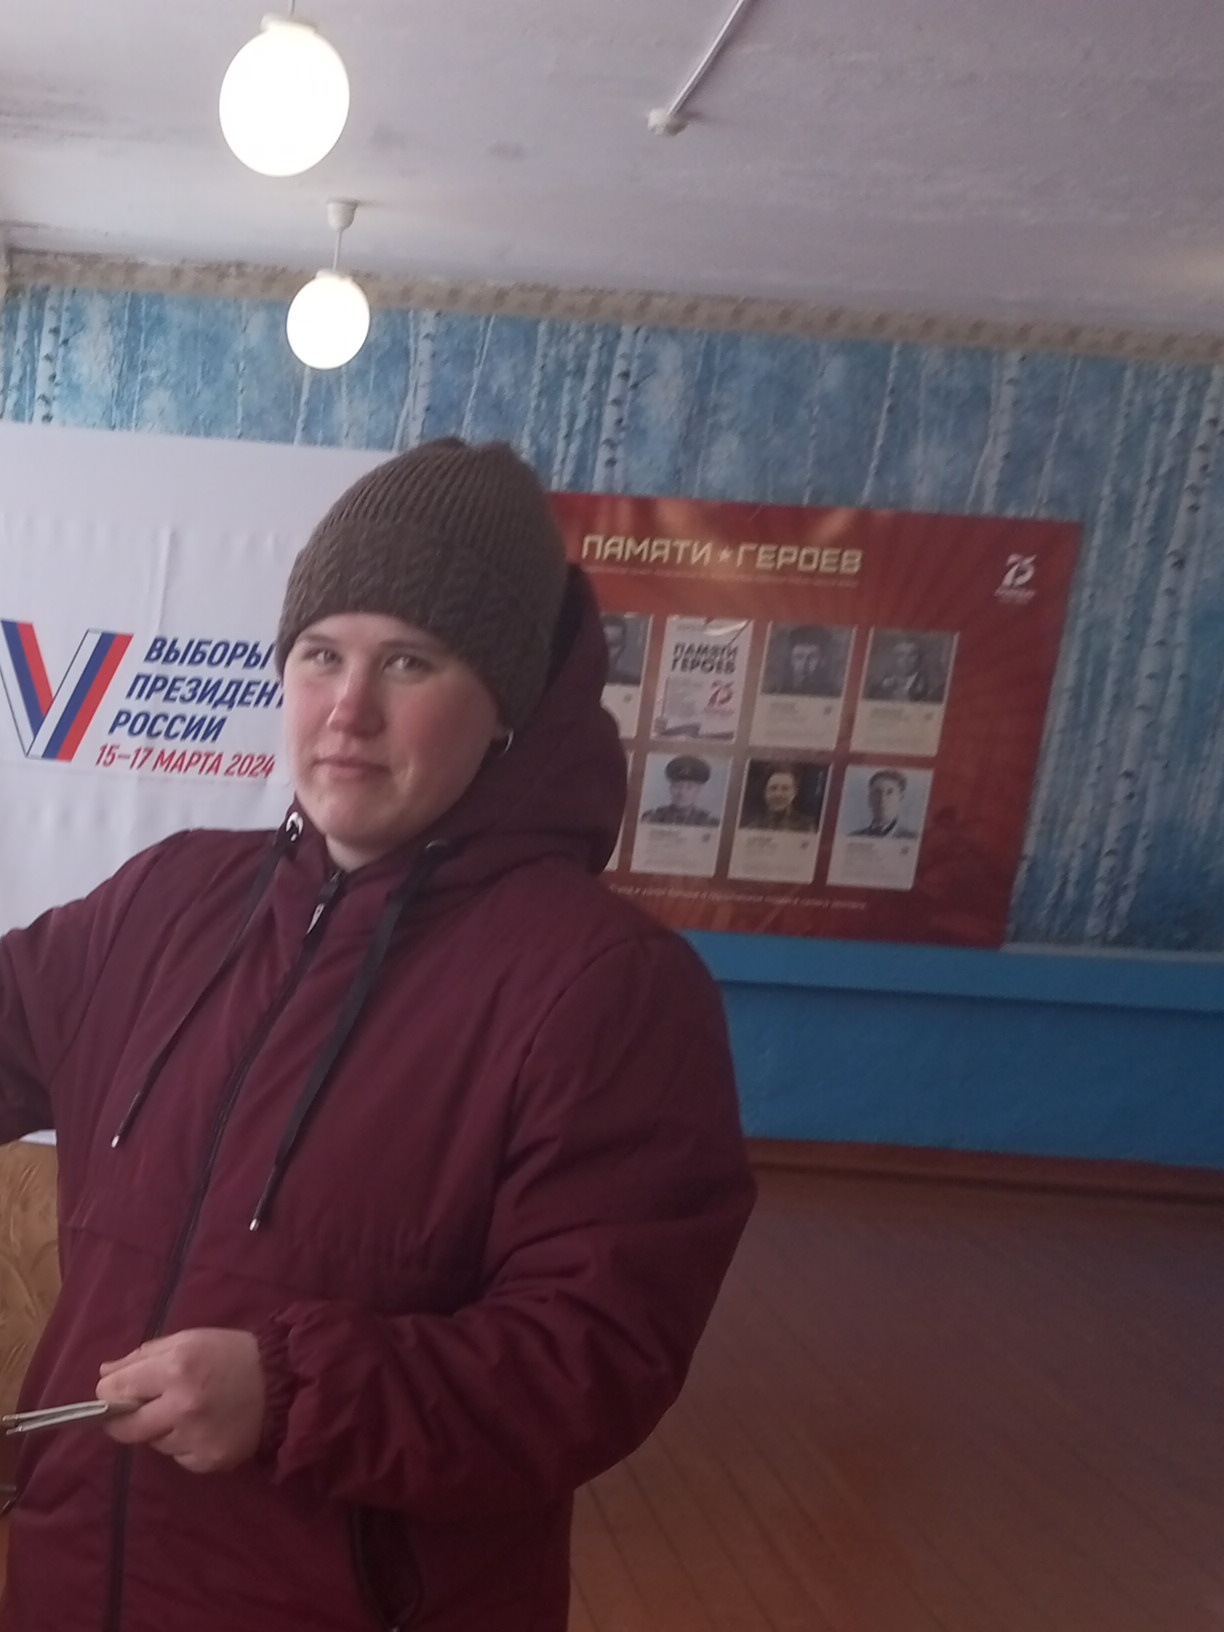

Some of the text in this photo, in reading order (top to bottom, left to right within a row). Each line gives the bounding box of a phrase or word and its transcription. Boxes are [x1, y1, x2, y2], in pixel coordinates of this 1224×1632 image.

[581, 534, 863, 574] ПАМЯТИ ГЕРОЕВ
[144, 636, 275, 670] ВЫБОРЫ
[126, 673, 284, 711] ПРЕЗИДЕН
[108, 709, 227, 743] РОССИИ
[152, 749, 224, 775] МАРТА
[224, 753, 276, 778] 2024
